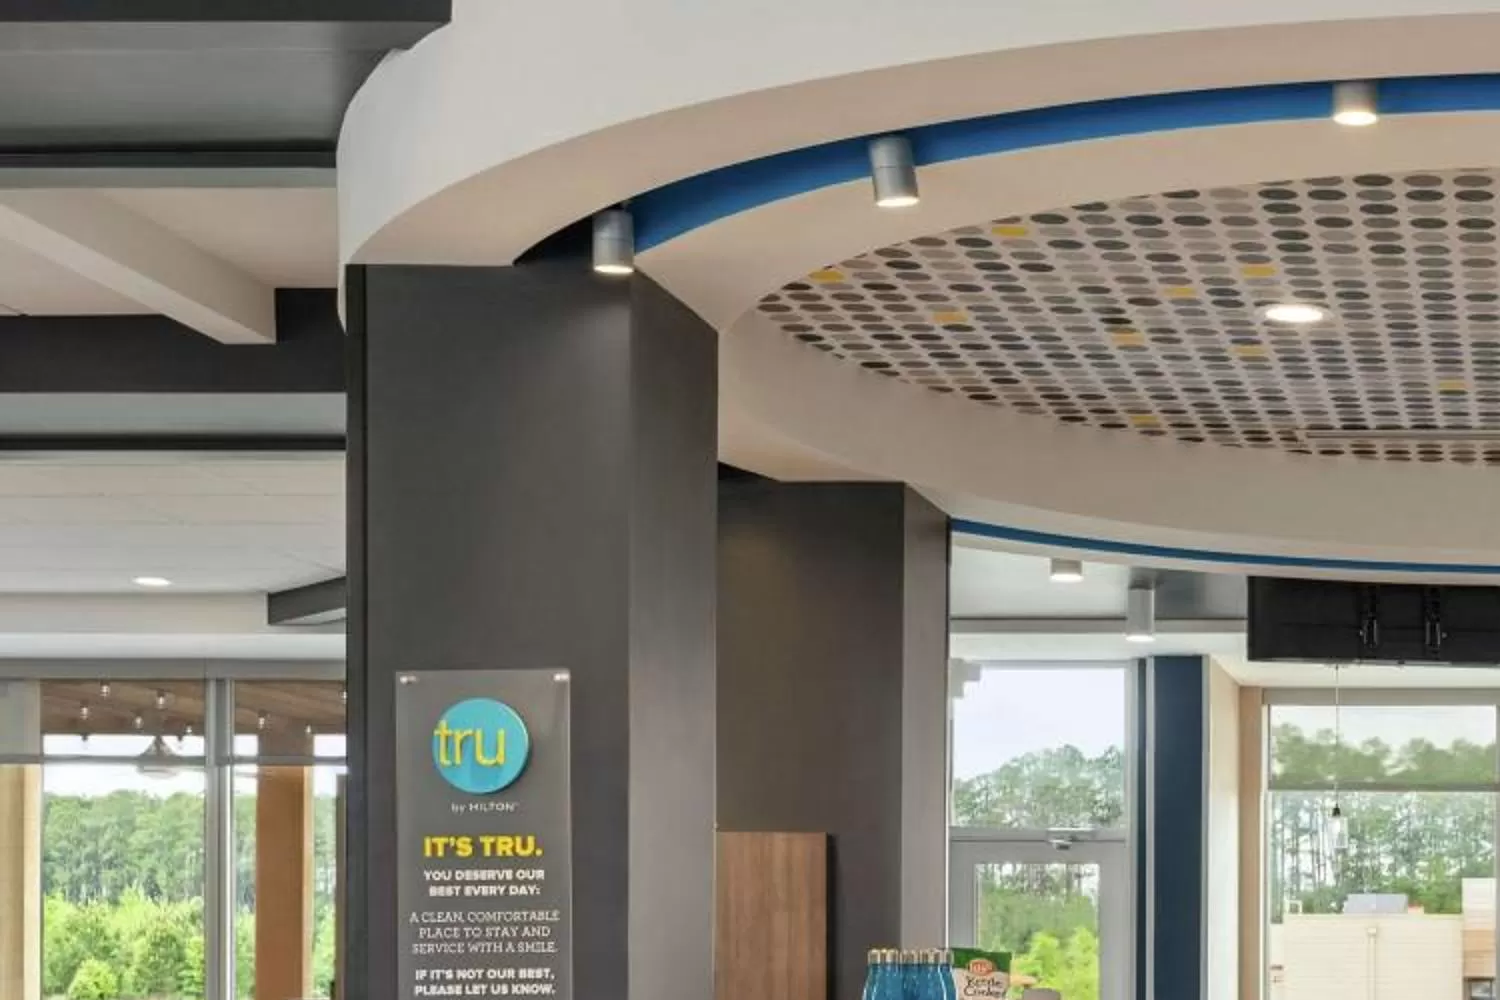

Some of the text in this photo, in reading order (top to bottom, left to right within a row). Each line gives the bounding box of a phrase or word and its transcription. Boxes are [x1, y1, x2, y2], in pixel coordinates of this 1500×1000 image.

[433, 719, 506, 766] tru
[469, 802, 515, 813] HILTON
[424, 835, 543, 857] IT'S TRU.
[424, 869, 545, 881] YOU DESERVE OUR
[429, 886, 461, 897] BEST
[464, 885, 506, 896] EVERY
[409, 911, 420, 923] A
[467, 910, 560, 923] COMFORTABLE
[419, 925, 551, 939] PLACE TO STAY AND
[412, 942, 465, 954] SERVICE
[467, 941, 503, 953] WITH
[505, 941, 515, 953] A
[415, 969, 427, 980] IF
[430, 969, 453, 980] IT'S
[456, 969, 484, 980] NOT
[486, 969, 515, 980] OUR
[414, 984, 556, 996] PLEASE LET US KNOW.
